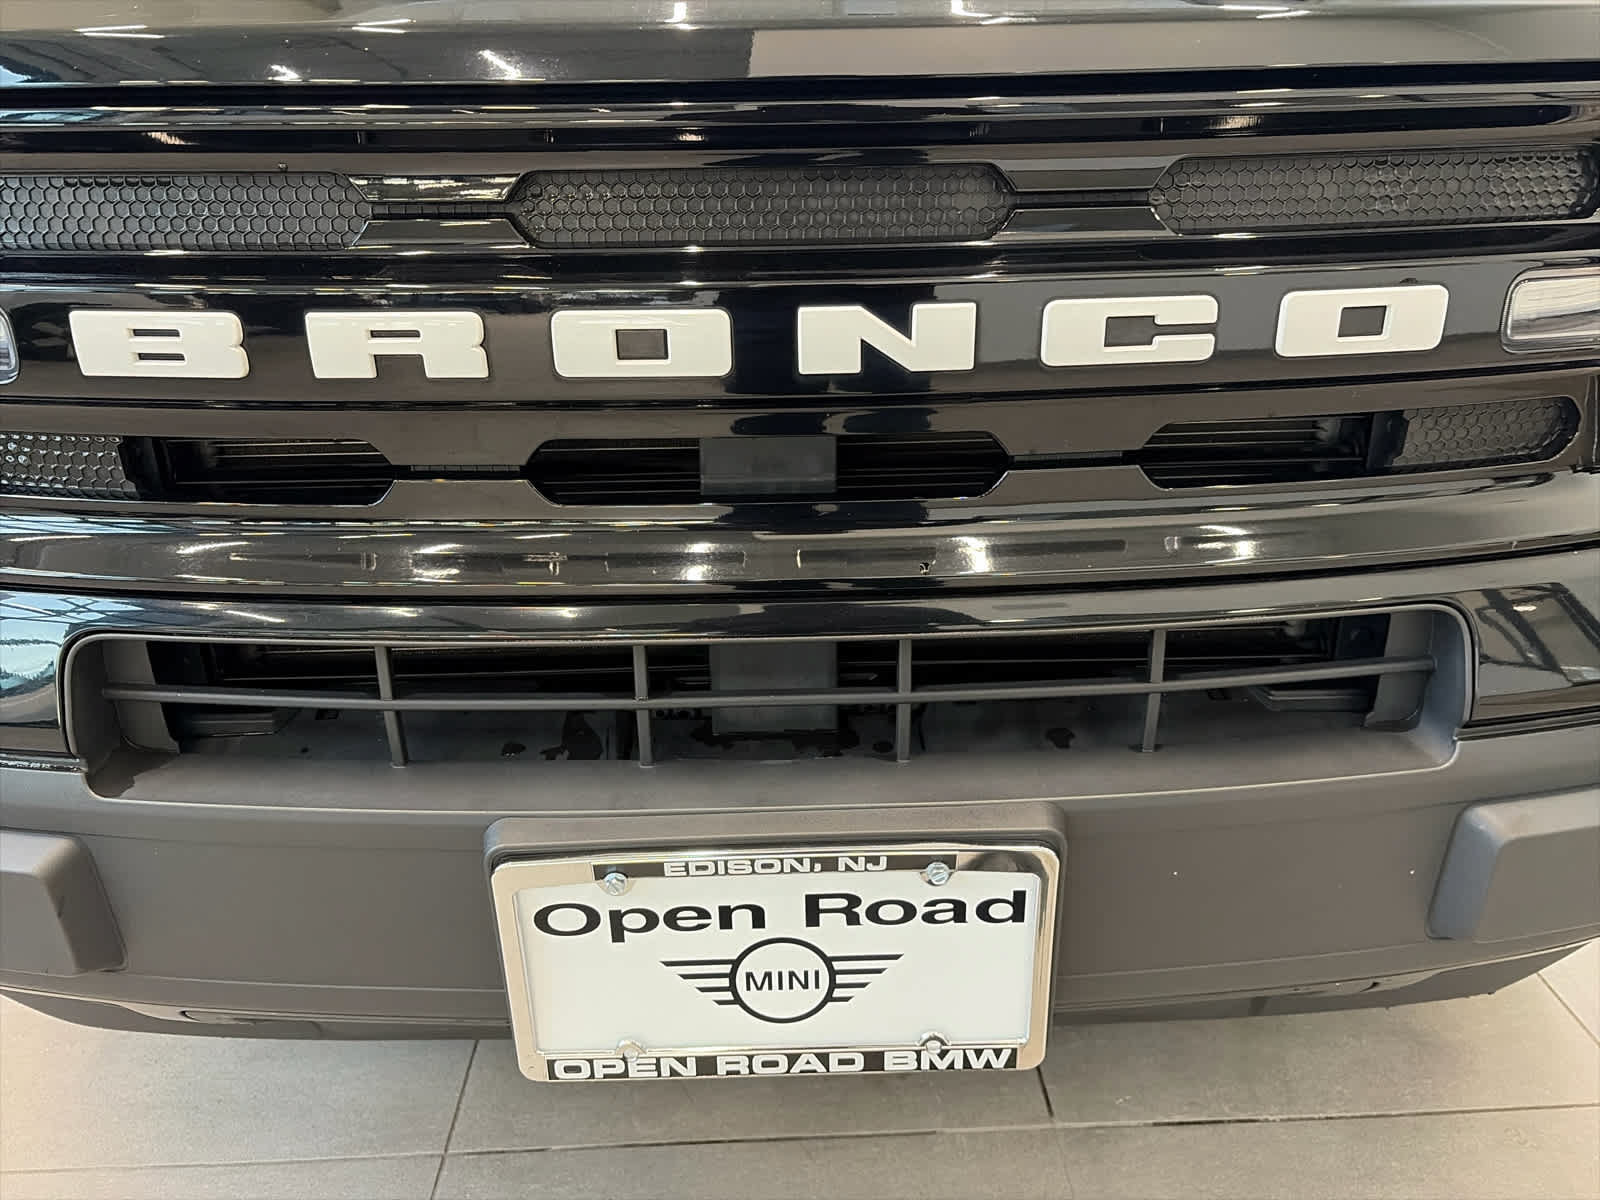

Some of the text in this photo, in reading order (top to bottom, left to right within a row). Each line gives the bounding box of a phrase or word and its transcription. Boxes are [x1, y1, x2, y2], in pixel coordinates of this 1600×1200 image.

[68, 284, 1449, 379] BRONCO
[663, 855, 889, 877] EDISON, NJ
[532, 890, 1027, 944] Open Road
[744, 968, 822, 992] MINI
[553, 1048, 1012, 1080] OPEN ROAD BMW
